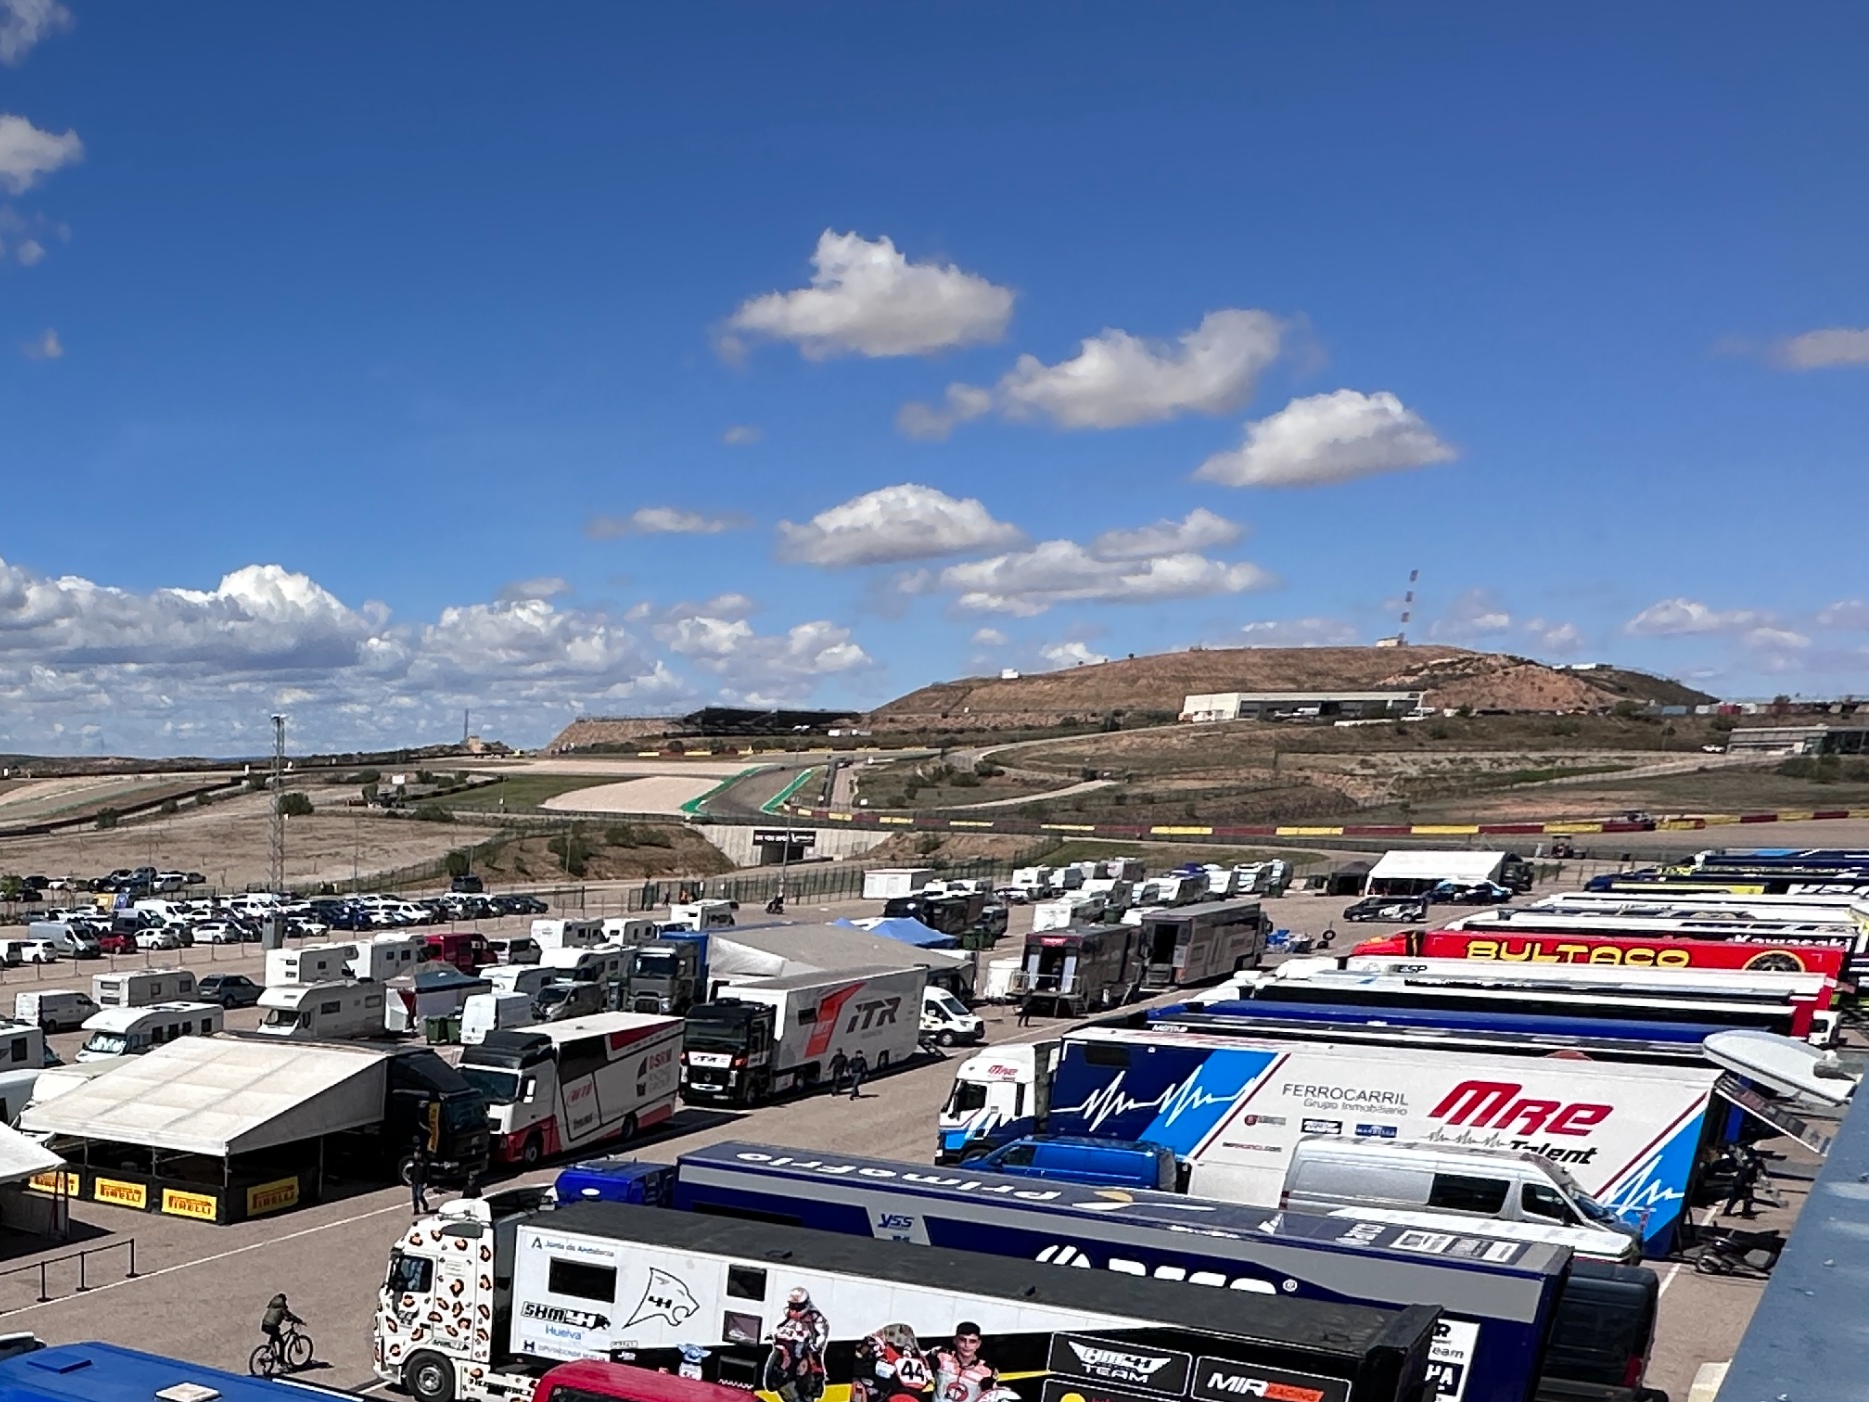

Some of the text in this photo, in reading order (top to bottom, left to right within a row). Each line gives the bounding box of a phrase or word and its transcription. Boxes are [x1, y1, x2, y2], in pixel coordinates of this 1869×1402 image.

[1467, 940, 1691, 968] BULTACO
[1282, 1083, 1409, 1106] FERROCARRIL
[1303, 1098, 1338, 1110] Grupo
[545, 1325, 582, 1340] Huelva
[901, 1360, 925, 1381] 44
[1081, 1362, 1149, 1383] TEAM
[1207, 1372, 1269, 1398] MIR
